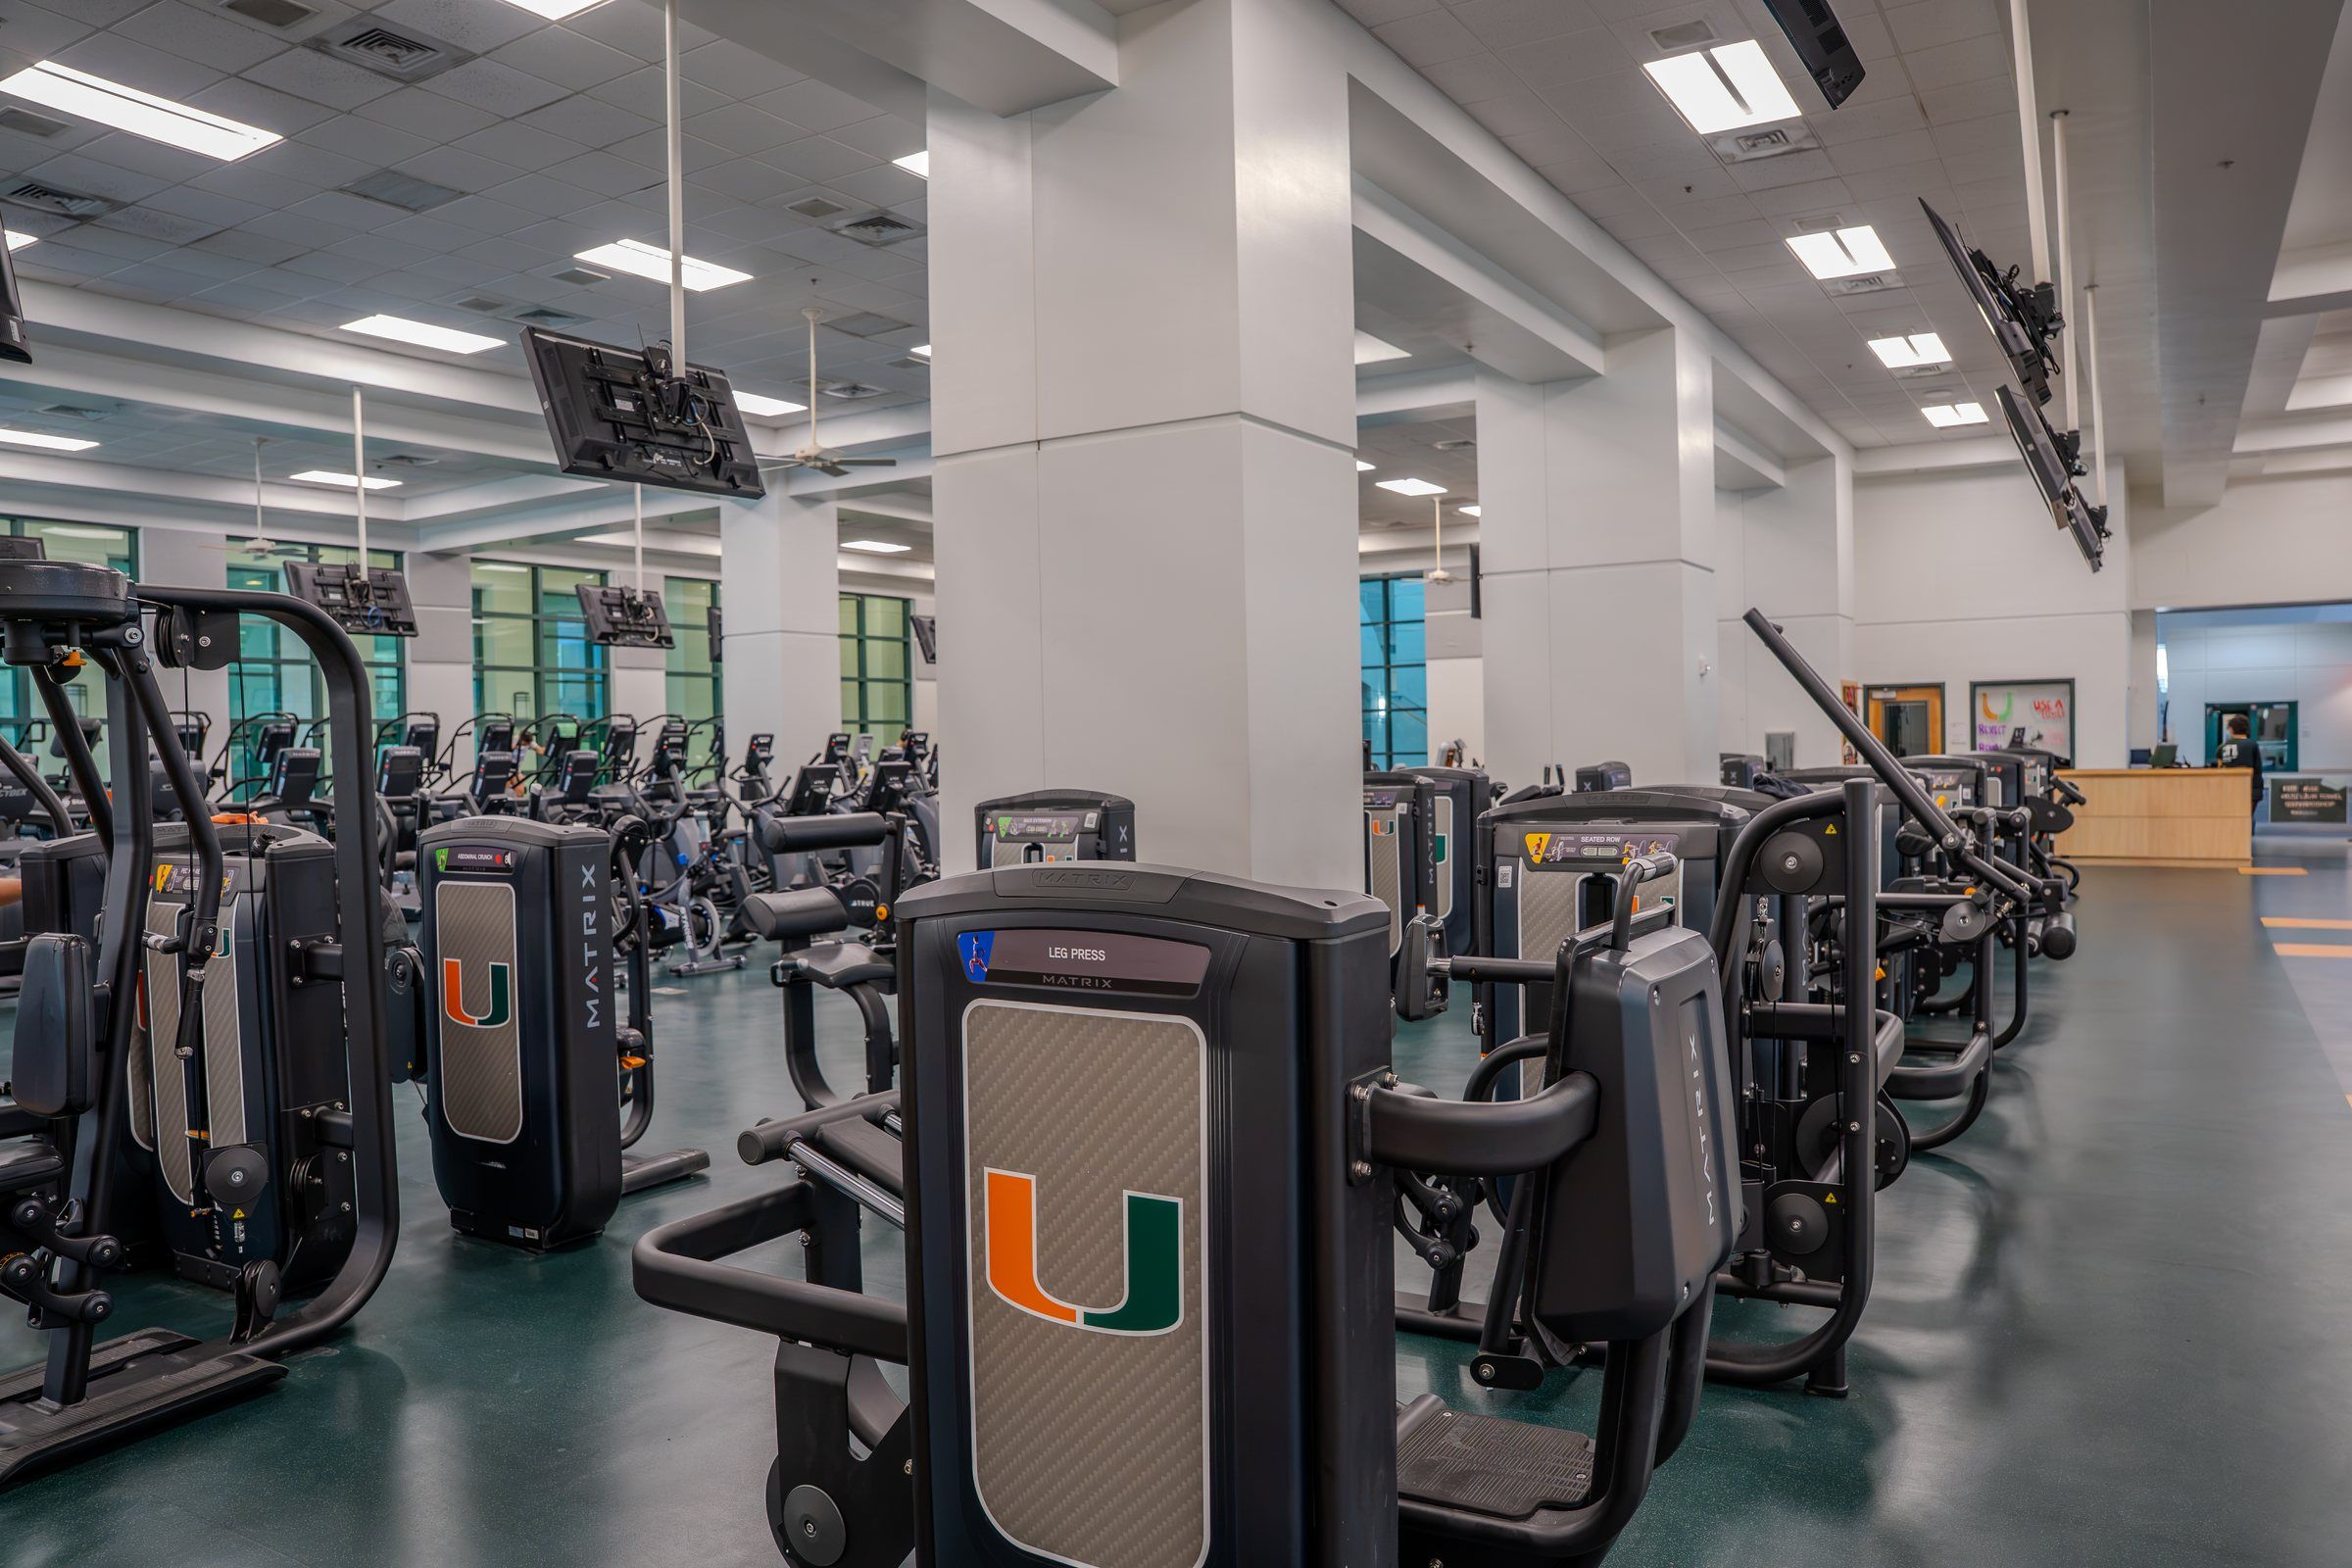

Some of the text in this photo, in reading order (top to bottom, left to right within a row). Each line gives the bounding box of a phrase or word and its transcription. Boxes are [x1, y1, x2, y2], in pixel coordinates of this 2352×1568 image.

[582, 863, 601, 1028] MATRIX
[1042, 974, 1112, 989] MATRIX
[1049, 947, 1106, 961] LEG PRESS
[1689, 1034, 1715, 1226] MATRIX
